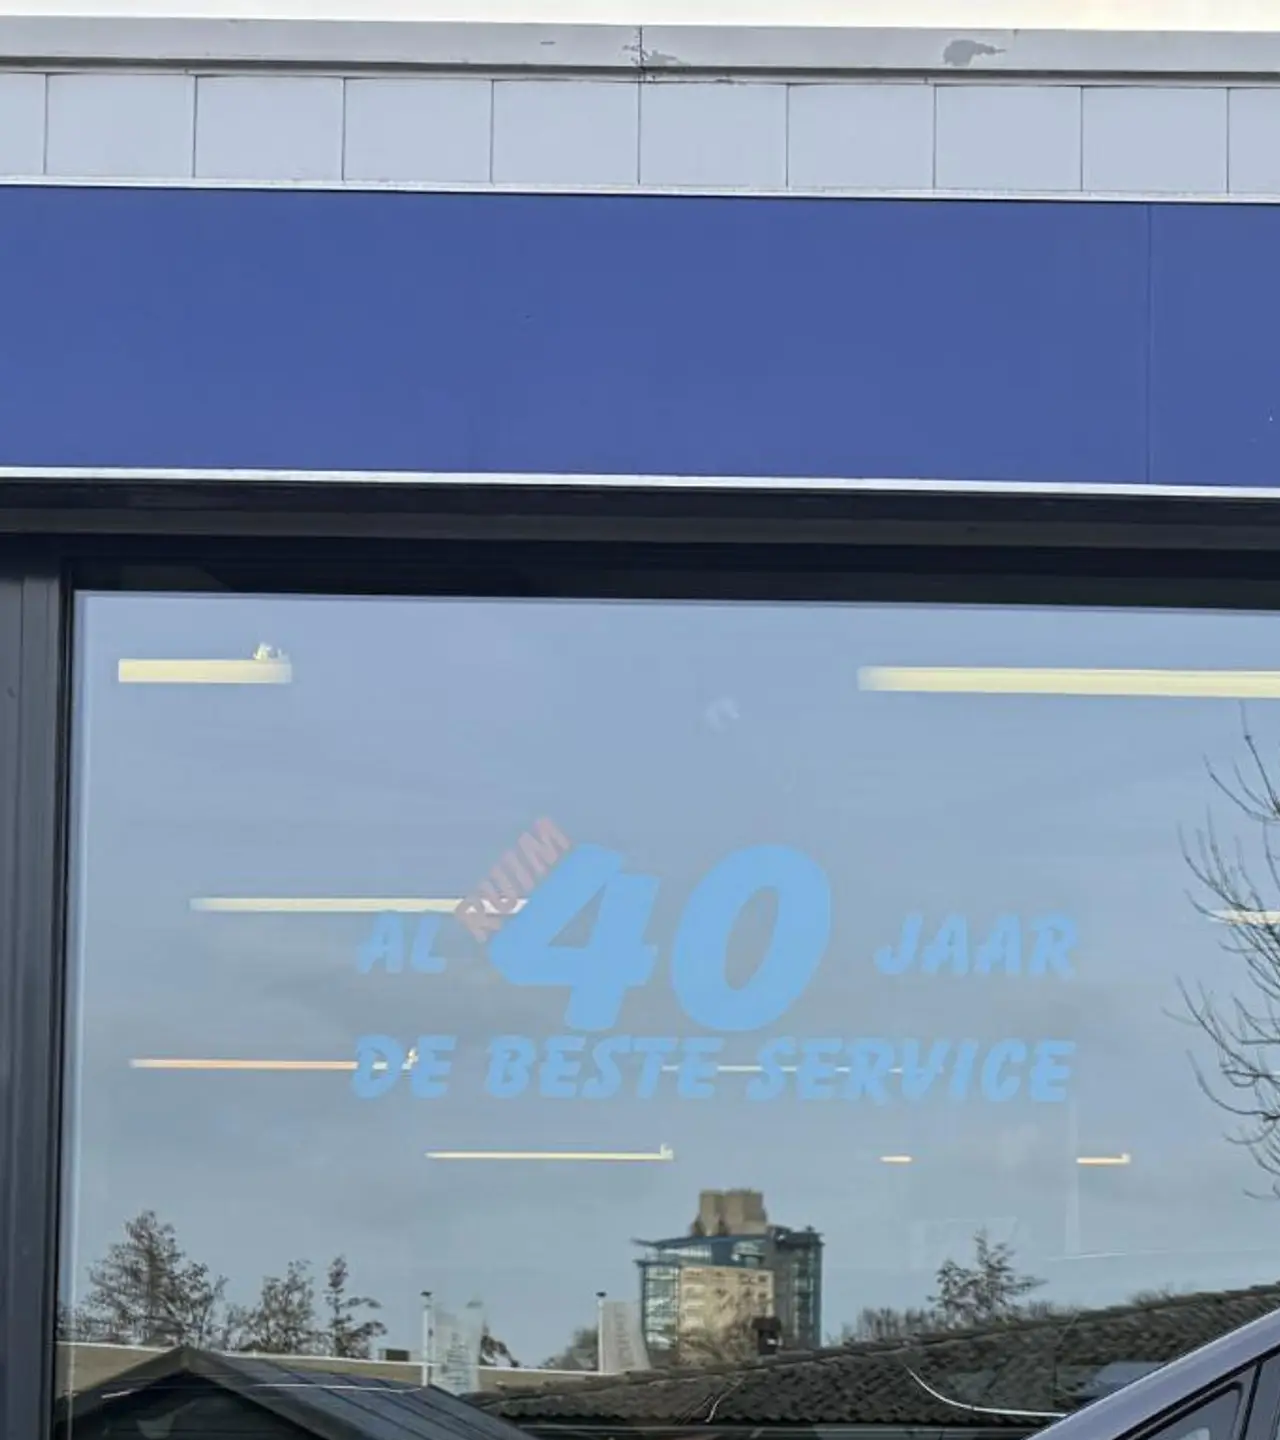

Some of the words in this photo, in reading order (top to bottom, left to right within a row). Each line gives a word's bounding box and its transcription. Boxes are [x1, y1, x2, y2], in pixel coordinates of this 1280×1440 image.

[355, 913, 447, 974] AL
[487, 843, 832, 1032] 40
[873, 911, 1079, 979] JAAR
[454, 816, 572, 944] RUIM
[352, 1034, 457, 1099] DE
[485, 1034, 724, 1100] BESTE
[745, 1034, 1077, 1106] SERVICE
